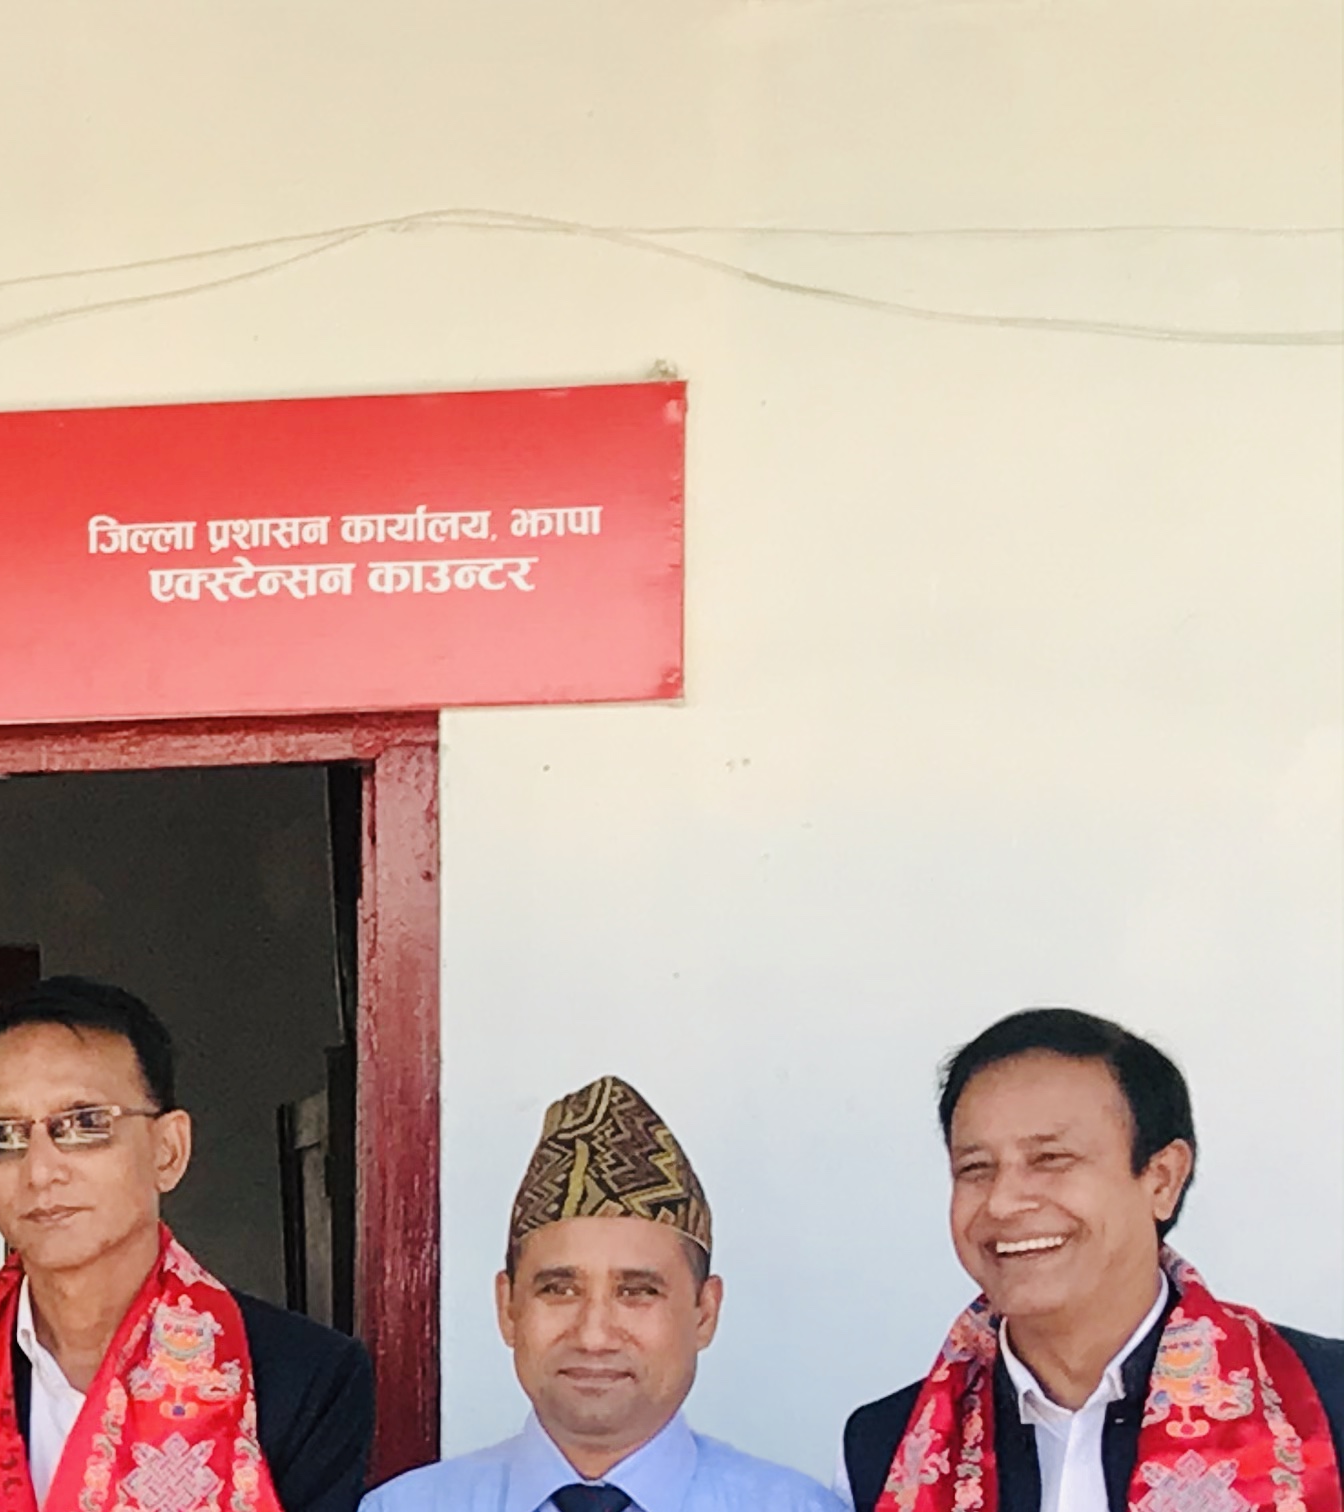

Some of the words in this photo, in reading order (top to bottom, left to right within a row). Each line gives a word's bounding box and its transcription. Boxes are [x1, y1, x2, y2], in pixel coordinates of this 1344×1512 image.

[87, 513, 198, 554] जिल्ला
[206, 515, 332, 554] प्रशासन
[510, 505, 604, 538] झापा
[148, 556, 356, 603] एक्स्टेन्सन
[368, 556, 540, 594] काउन्टर
